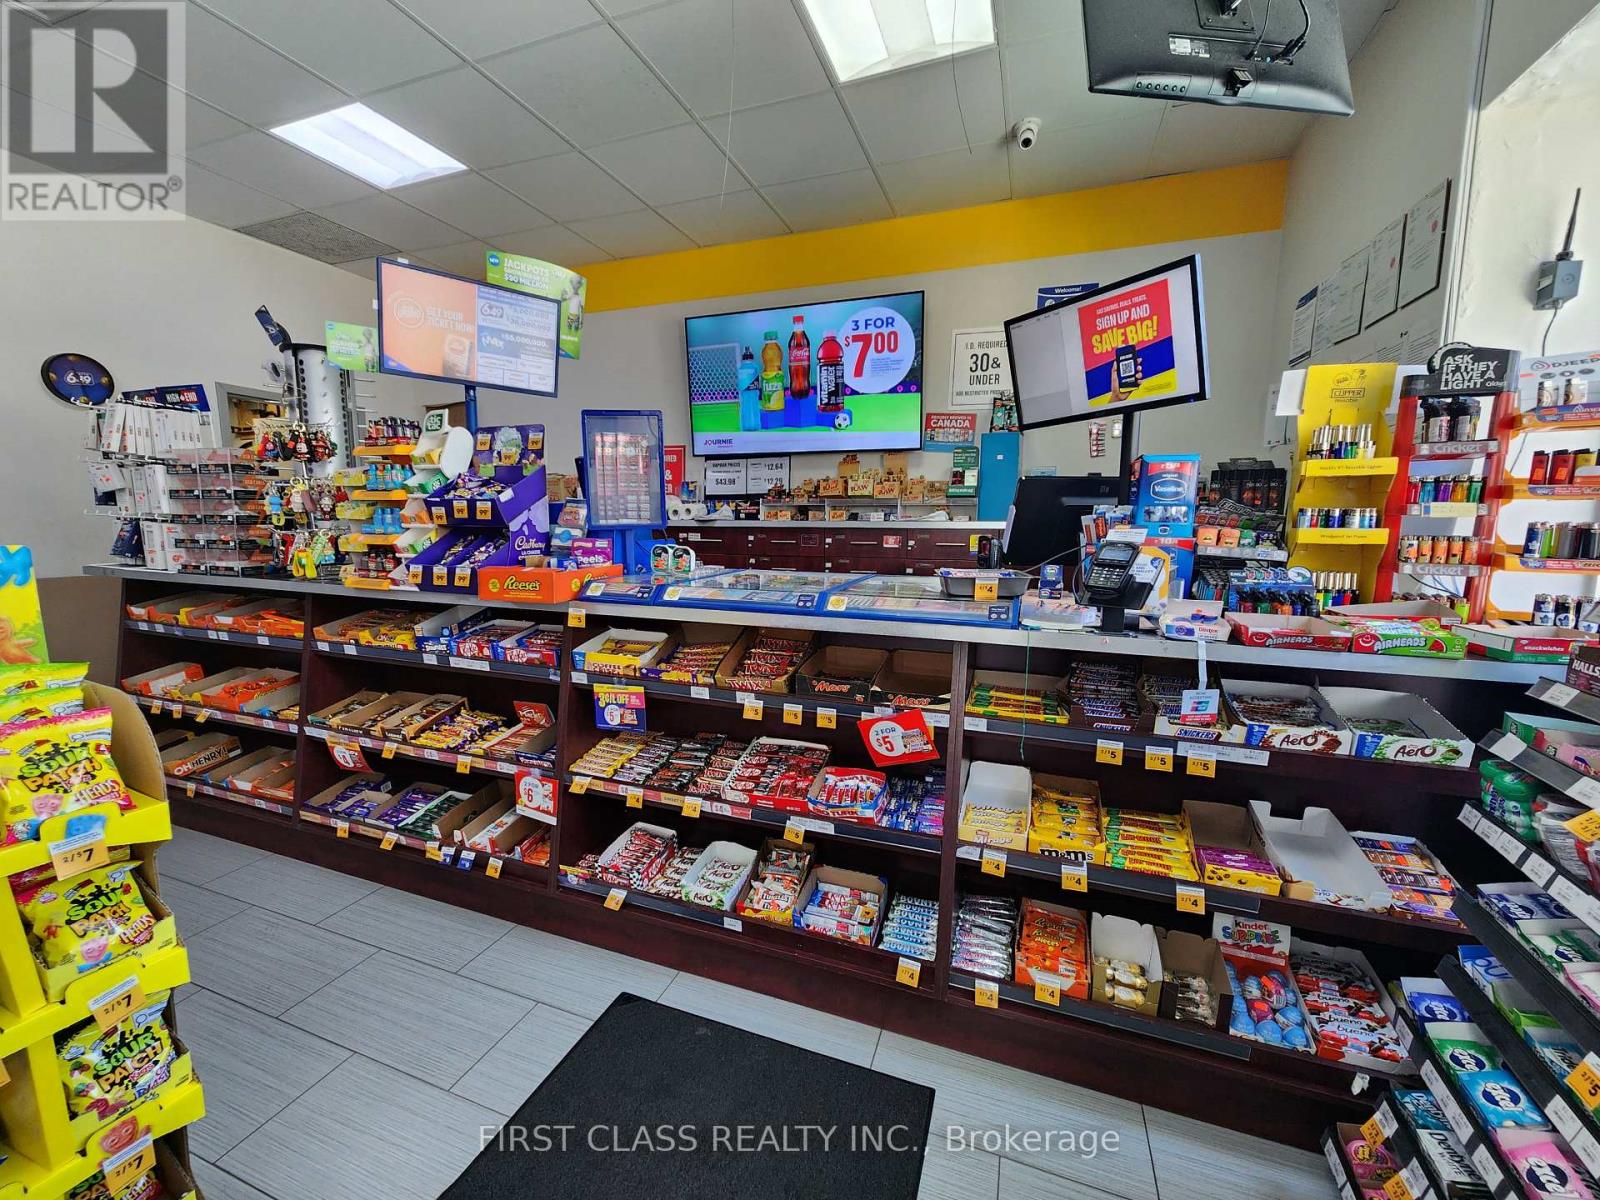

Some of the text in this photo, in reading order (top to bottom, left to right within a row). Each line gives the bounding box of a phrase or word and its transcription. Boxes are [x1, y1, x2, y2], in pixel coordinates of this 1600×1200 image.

[1054, 285, 1082, 294] Welcome!
[851, 316, 896, 331] 3 FOR
[1096, 304, 1150, 331] SIGN UP AND
[1091, 315, 1158, 354] SAVE BIG!
[977, 340, 1008, 349] REQUIRED
[1443, 354, 1474, 365] ASK
[1443, 361, 1498, 373] IF THEY
[969, 374, 1000, 386] UNDER
[1441, 370, 1495, 381] HAVE A
[1440, 379, 1484, 390] LIGHT
[184, 391, 197, 403] END
[1332, 388, 1363, 398] CLIPPER
[428, 414, 442, 425] tic
[930, 419, 970, 428] CANADA
[428, 423, 441, 432] tac
[1434, 443, 1480, 453] Cricket
[1154, 485, 1184, 493] Vaseline
[515, 536, 546, 551] Cadbury
[577, 555, 604, 564] Peels
[1416, 566, 1465, 575] Cricket
[504, 575, 540, 591] Reese's
[1265, 634, 1313, 647] AIRHEADS
[1374, 637, 1426, 652] AIRHEADS
[1571, 659, 1600, 677] HALLS
[815, 680, 850, 693] Mars
[1177, 728, 1217, 739] SNICKERS
[876, 735, 895, 752] $5
[18, 745, 91, 778] SOUR
[173, 747, 228, 776] OH HENRY!
[21, 758, 103, 793] PATCH
[75, 779, 120, 804] HEADS
[67, 889, 125, 921] SOUR
[119, 913, 155, 943] HEADS
[1222, 926, 1281, 944] SURPRISE
[1317, 994, 1350, 1003] bueno
[1328, 1015, 1363, 1026] bueno
[1336, 1024, 1375, 1037] bueno
[94, 1031, 156, 1075] SOUR
[98, 1041, 163, 1092] PATCH
[1428, 1132, 1482, 1180] Dentyne
